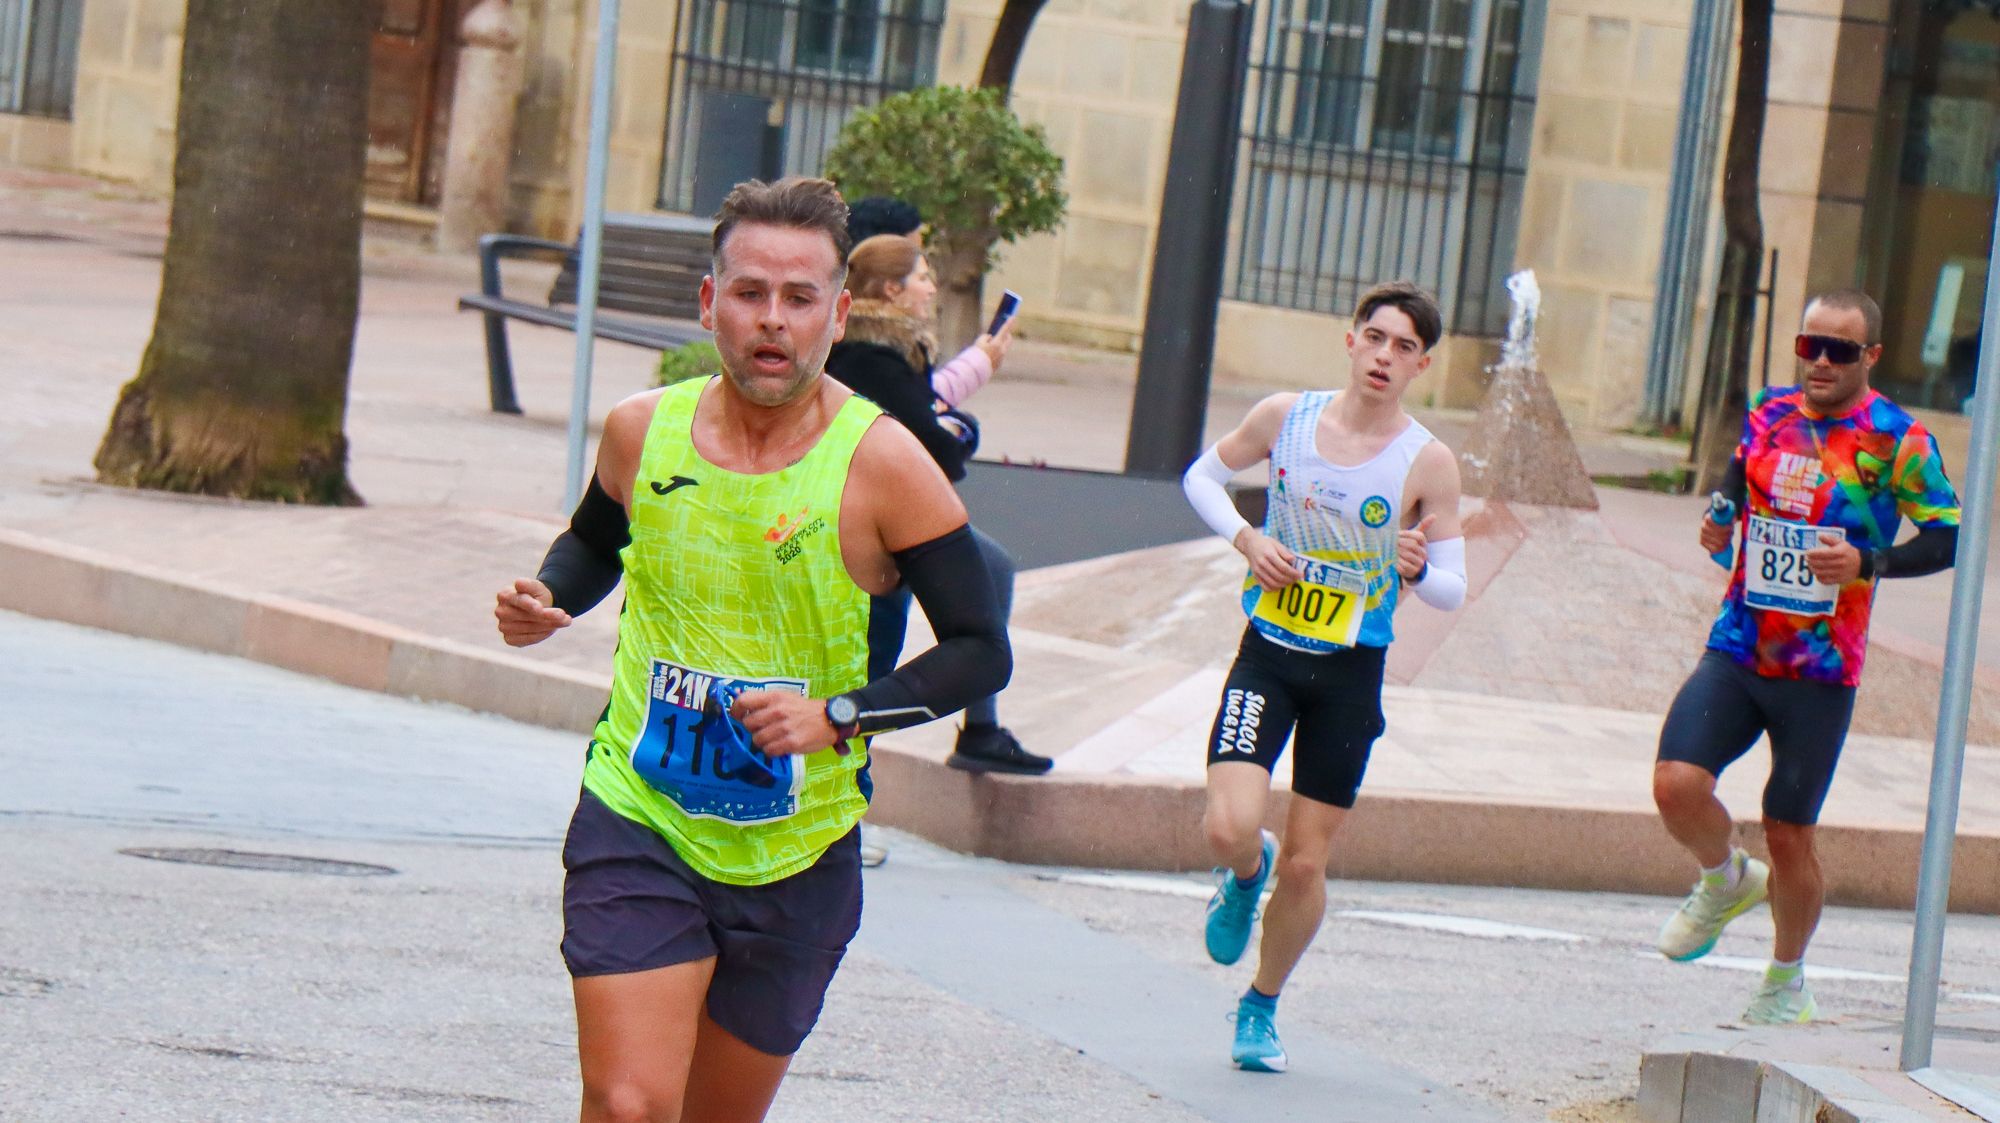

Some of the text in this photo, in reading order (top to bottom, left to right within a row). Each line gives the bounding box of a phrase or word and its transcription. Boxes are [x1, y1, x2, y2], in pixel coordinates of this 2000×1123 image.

[775, 516, 822, 553] NEW YORK CITY
[776, 521, 824, 560] MARATHON
[780, 546, 801, 565] 2020
[1761, 548, 1814, 587] 825
[1276, 583, 1346, 626] 1007
[665, 667, 712, 712] 21K
[1236, 690, 1266, 754] SURCO
